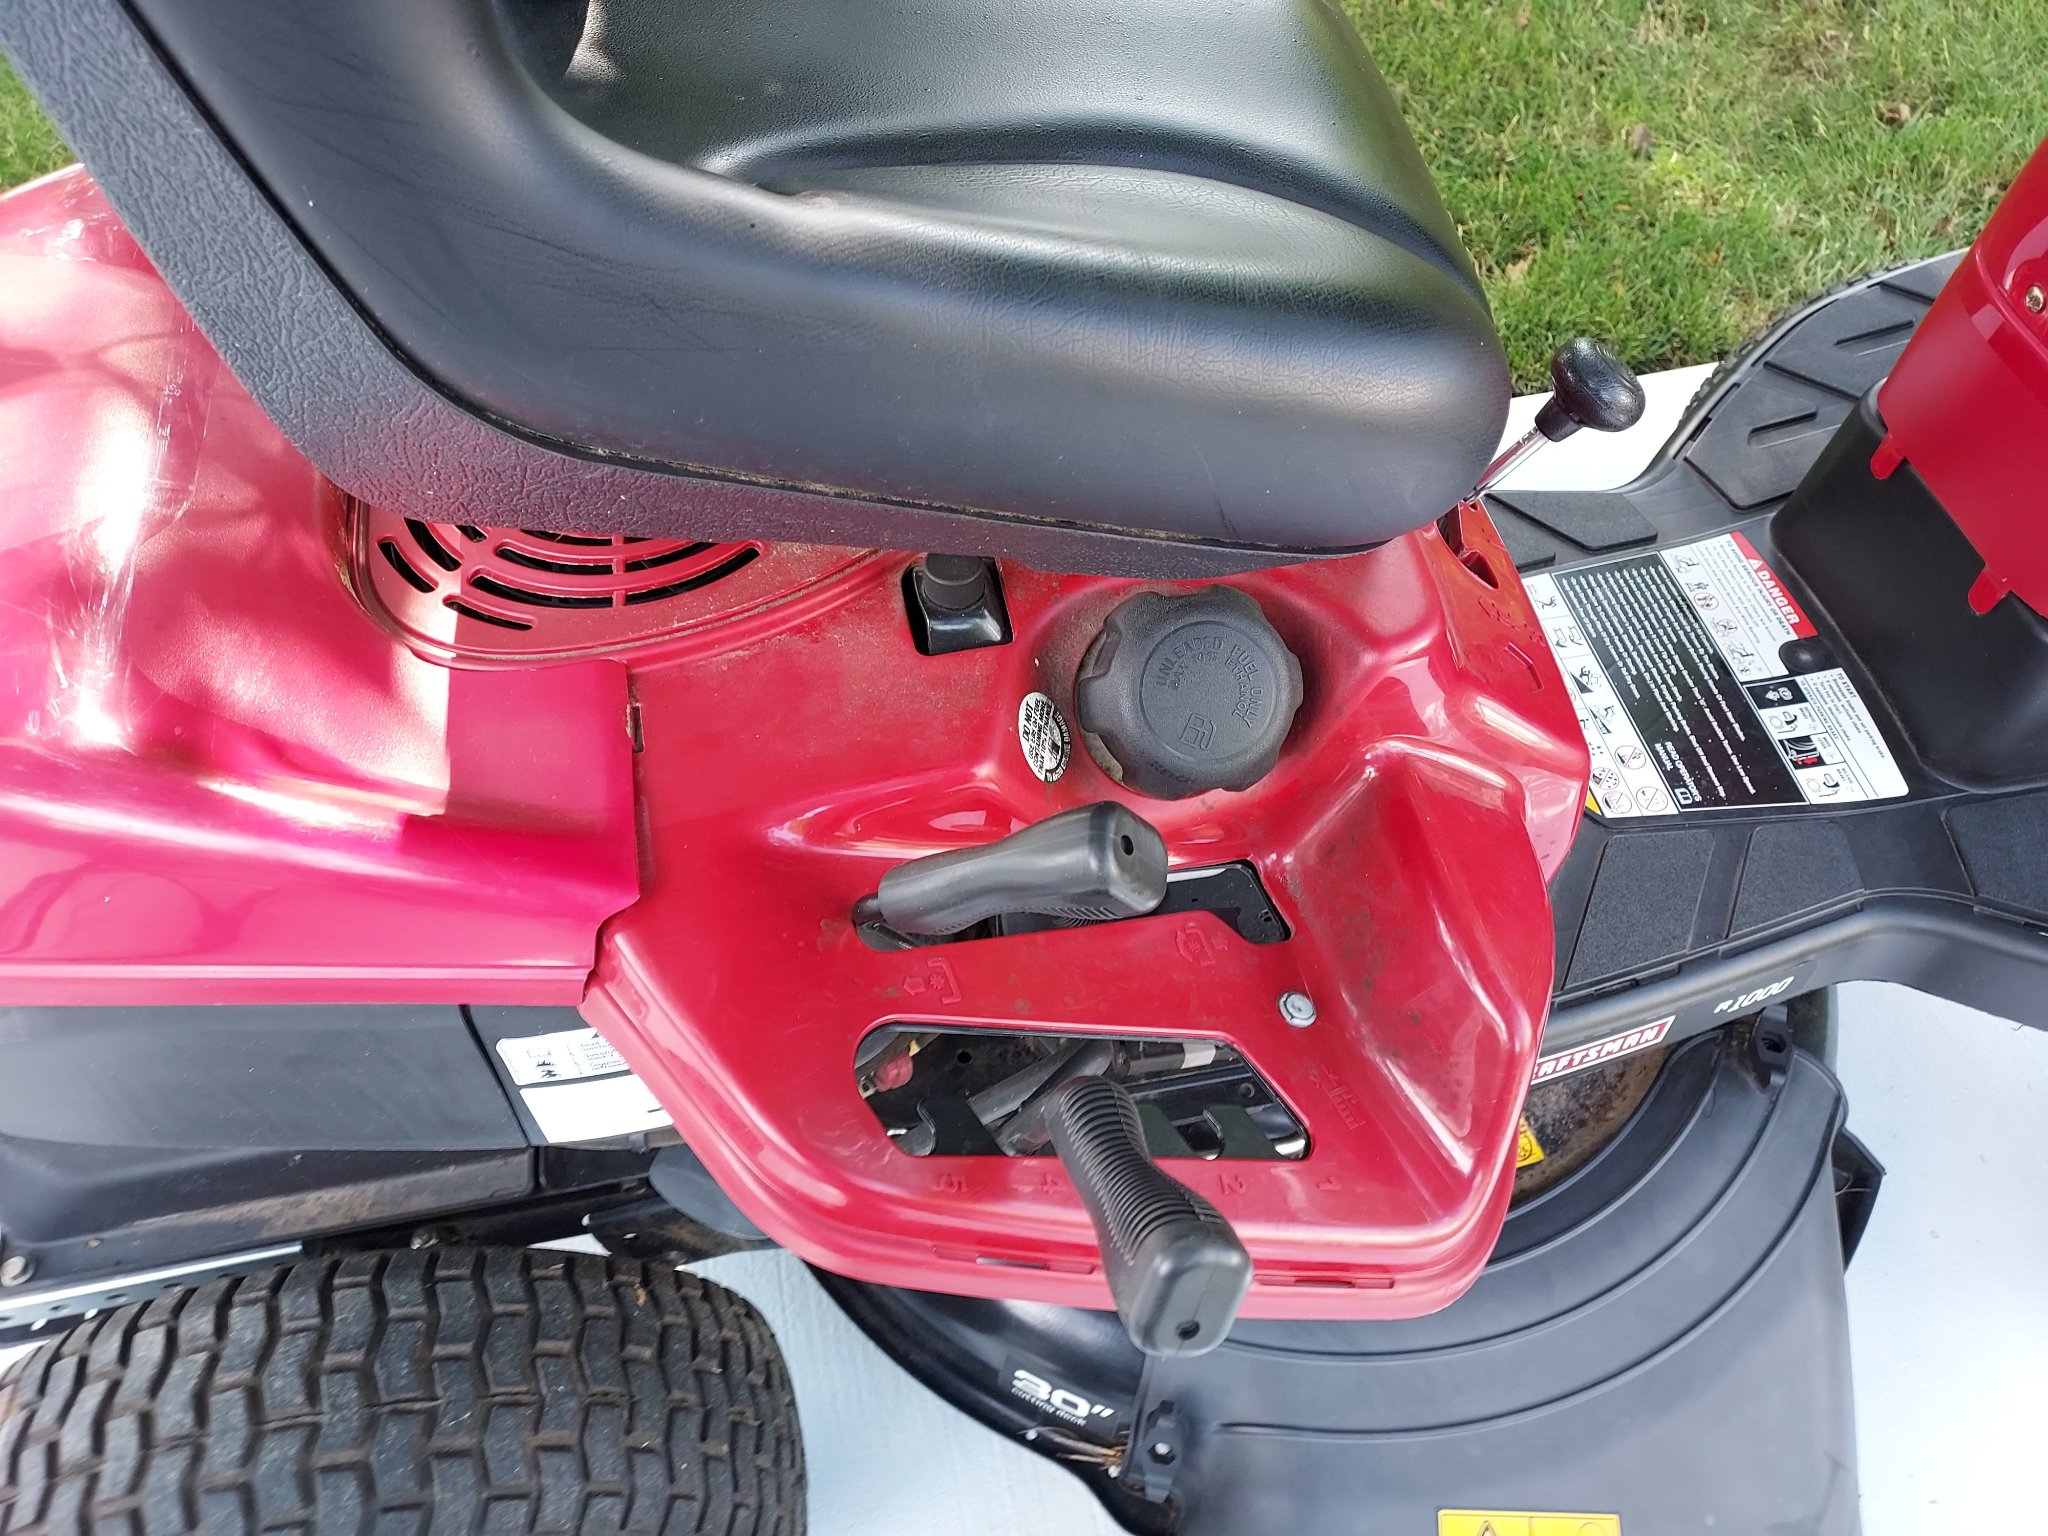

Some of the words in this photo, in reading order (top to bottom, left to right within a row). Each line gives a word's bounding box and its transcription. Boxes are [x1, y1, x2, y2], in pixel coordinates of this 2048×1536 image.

[1756, 569, 1802, 624] DANGER
[1775, 617, 1791, 635] DEATH
[1230, 644, 1259, 681] FUEL
[1225, 658, 1248, 718] ETHANOL
[1835, 672, 1845, 680] TO
[1841, 681, 1857, 698] START
[1024, 701, 1034, 726] NOT
[1243, 687, 1263, 728] ONLY
[1022, 724, 1031, 743] DO
[1054, 711, 1071, 742] DAMAGE
[1663, 741, 1681, 760] READ
[1714, 976, 1795, 1014] R1000
[1532, 1024, 1661, 1079] AFTSMAN
[1012, 1369, 1115, 1418] 30"
